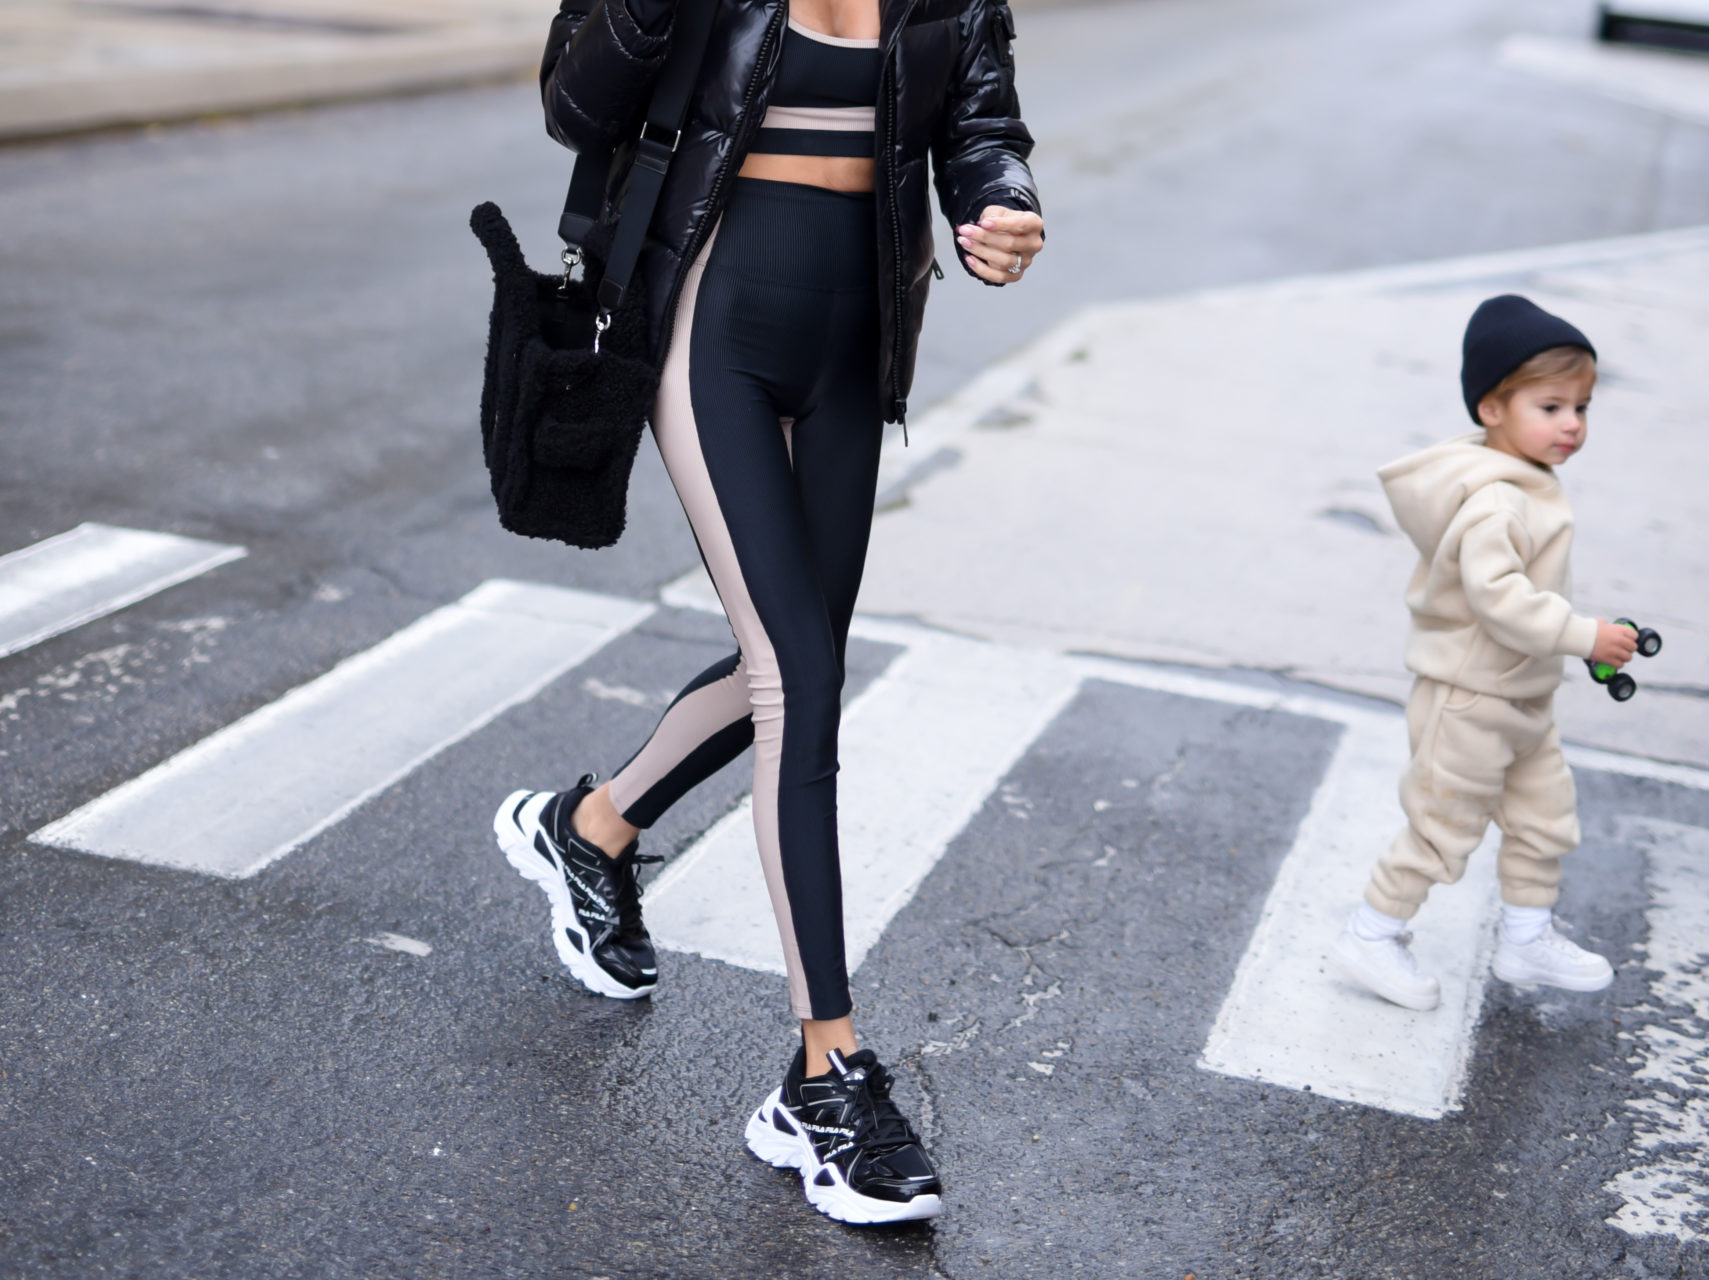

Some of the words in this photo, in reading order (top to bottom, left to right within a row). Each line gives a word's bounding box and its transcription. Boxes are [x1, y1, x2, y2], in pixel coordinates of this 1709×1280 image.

[575, 876, 585, 890] FILA
[585, 886, 597, 900] FILA
[596, 896, 610, 912] FILA
[578, 908, 590, 917] FILA
[590, 911, 605, 921] FILA
[811, 1124, 825, 1133] FILA
[825, 1126, 839, 1134] FILA
[839, 1128, 855, 1137] FILA
[823, 1149, 837, 1162] FILA
[838, 1141, 854, 1152] FILA
